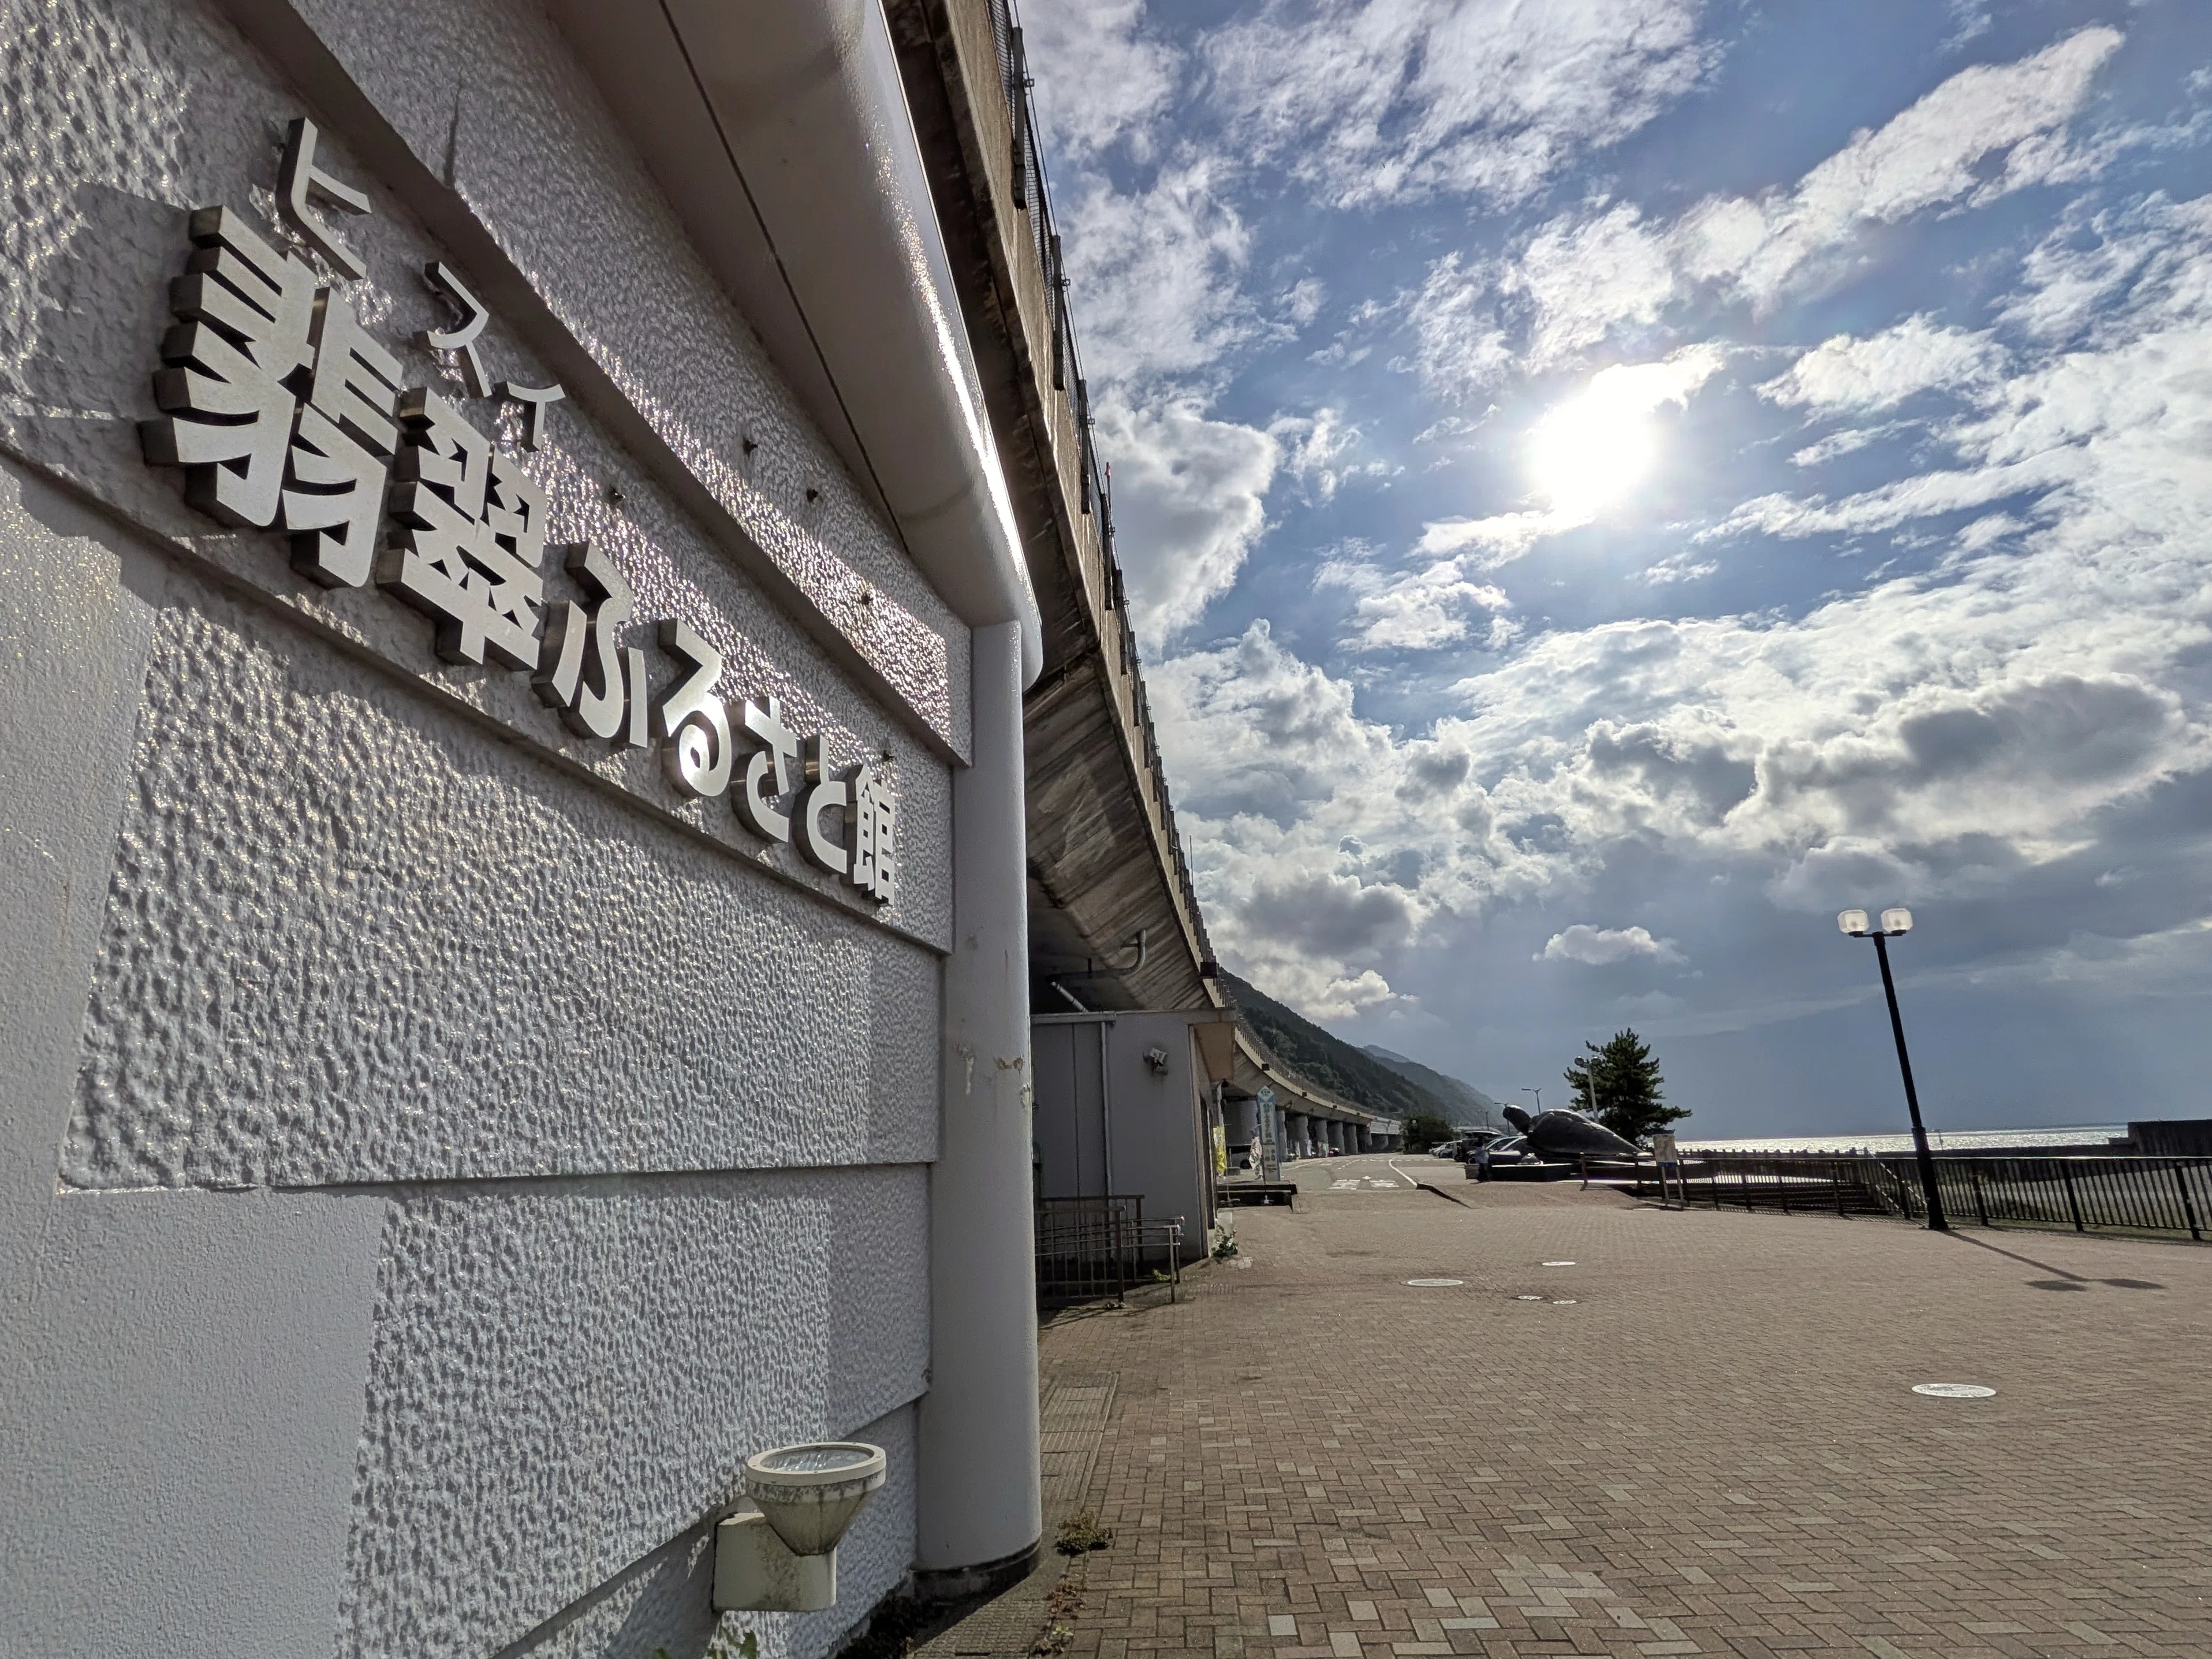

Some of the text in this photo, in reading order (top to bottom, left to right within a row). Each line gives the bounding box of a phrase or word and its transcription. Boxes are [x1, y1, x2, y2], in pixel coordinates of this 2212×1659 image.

[277, 117, 565, 453] ヒスイ
[141, 206, 896, 905] 翡翠ふるさと館
